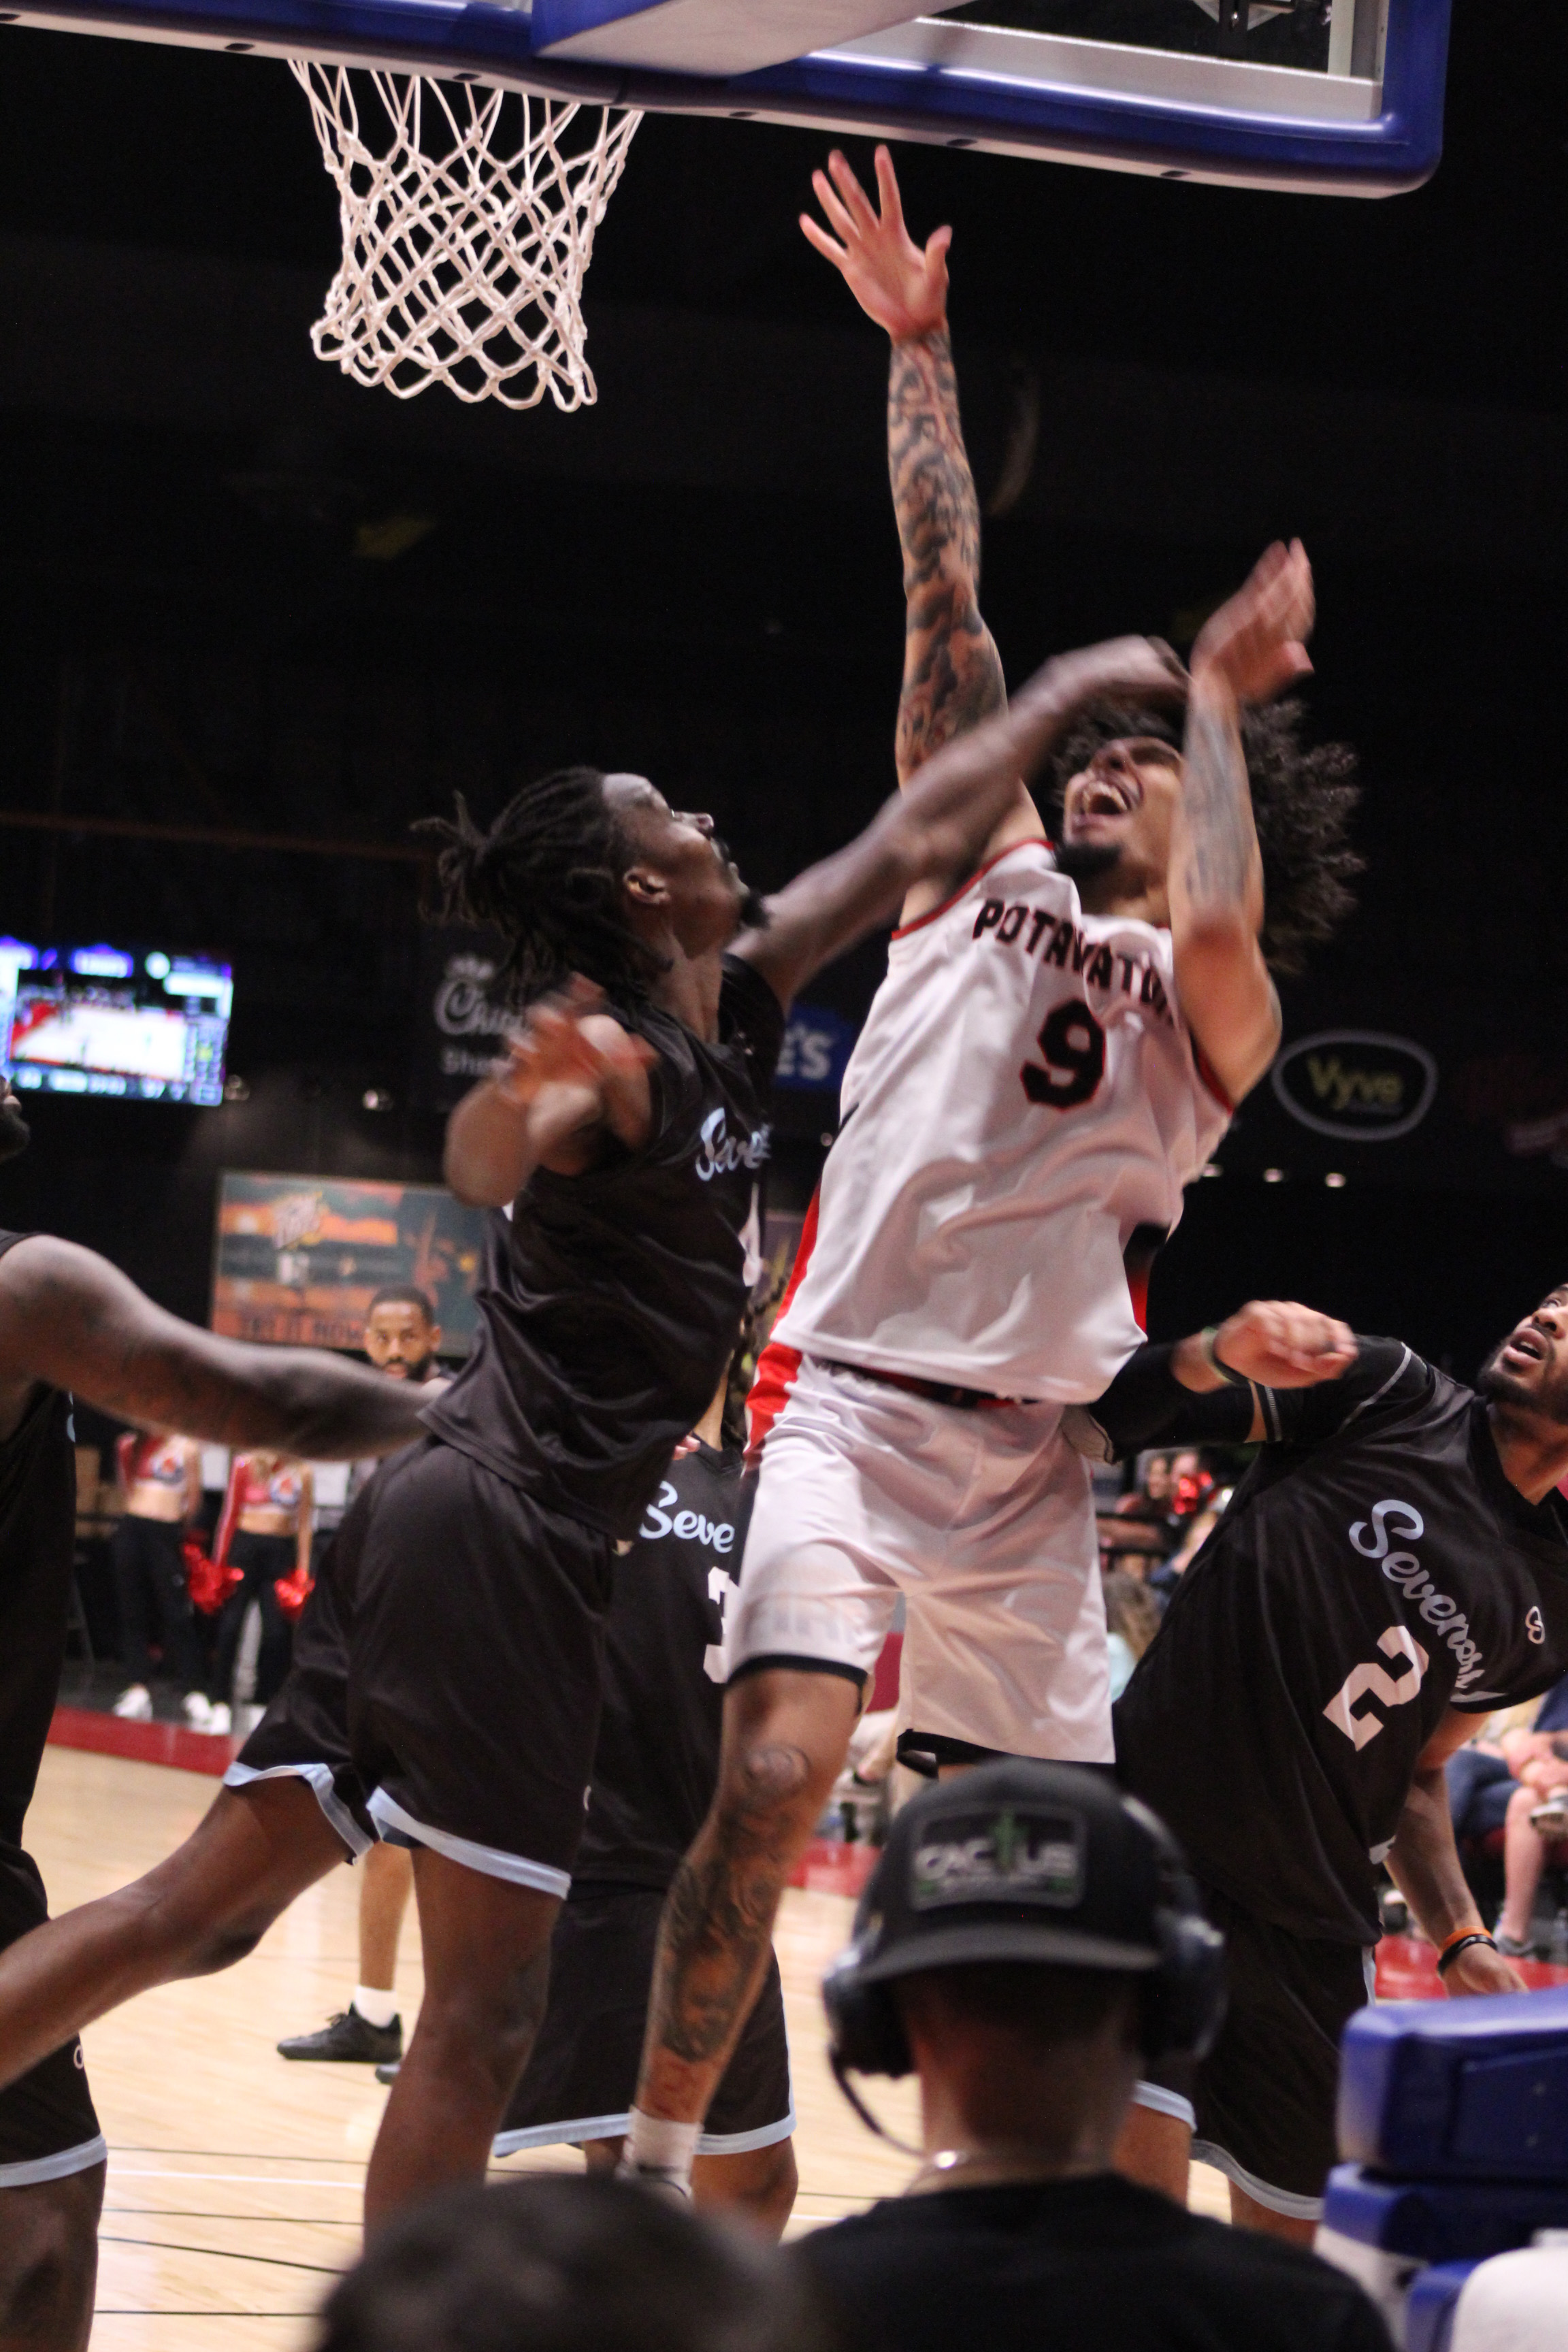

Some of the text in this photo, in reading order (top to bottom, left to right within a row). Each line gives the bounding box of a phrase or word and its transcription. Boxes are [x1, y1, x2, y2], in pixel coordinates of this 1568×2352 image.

[1019, 996, 1107, 1112] 9
[1307, 1054, 1404, 1111] Vyve
[1322, 1625, 1429, 1752] 2
